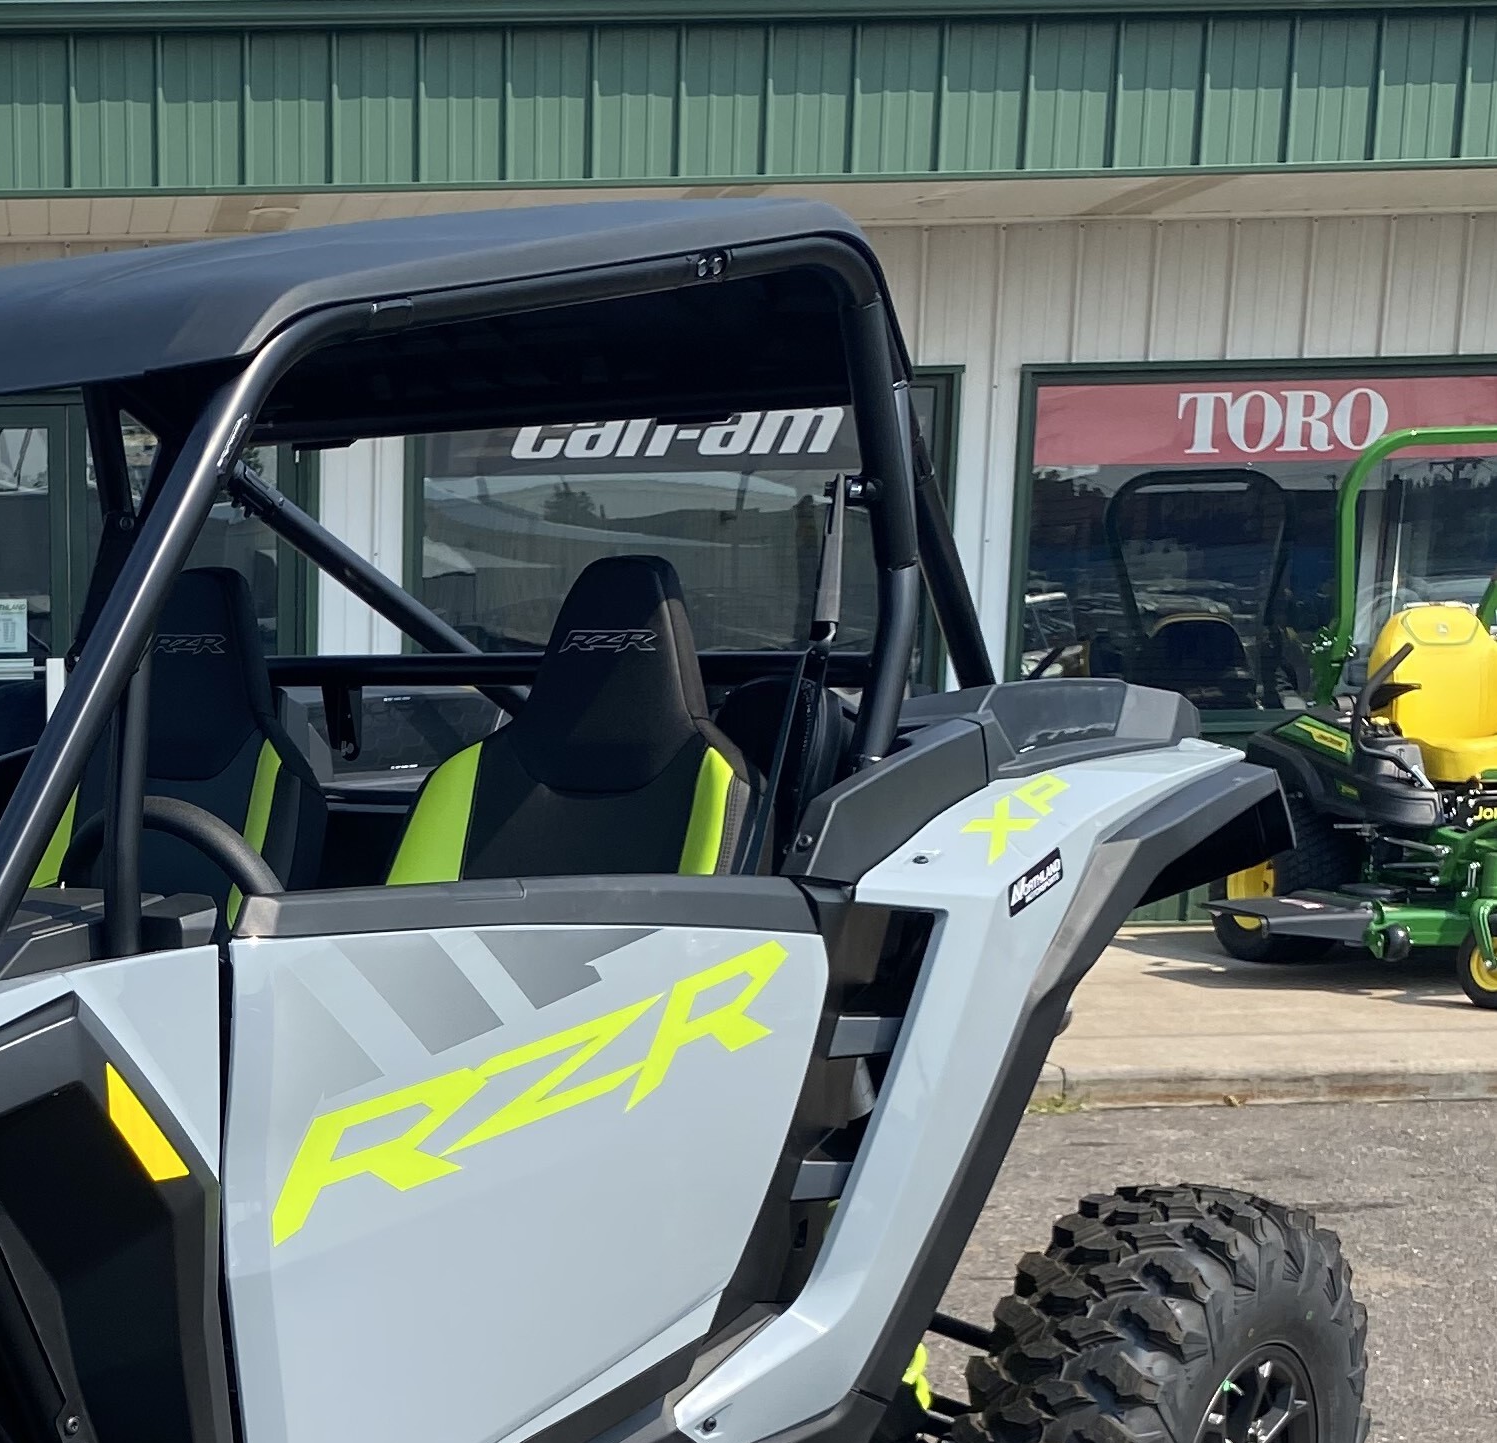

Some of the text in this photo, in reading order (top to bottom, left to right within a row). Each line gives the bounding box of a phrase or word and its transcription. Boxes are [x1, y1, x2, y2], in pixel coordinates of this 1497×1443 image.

[1177, 387, 1389, 453] TORO
[152, 633, 227, 655] RZR
[559, 629, 658, 654] RZR
[960, 774, 1070, 866] XP
[1472, 805, 1497, 821] JO
[270, 939, 790, 1248] RZR
